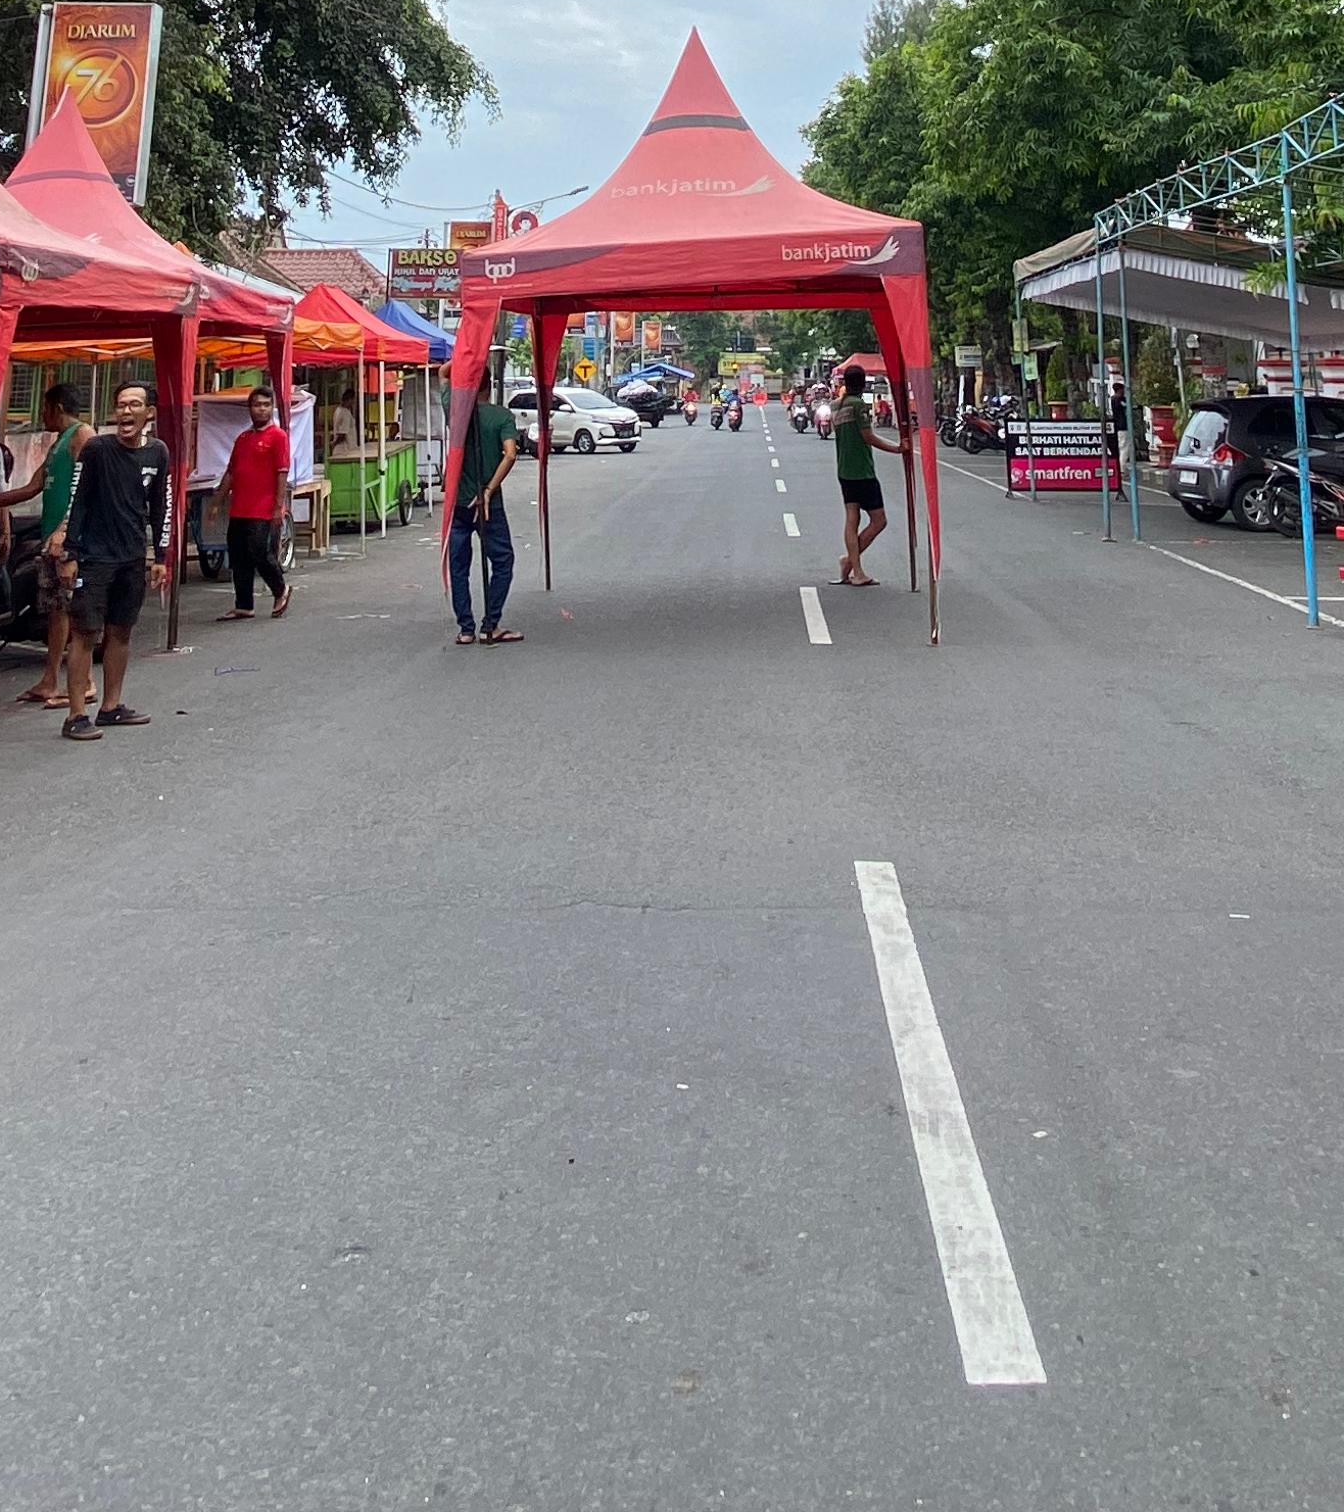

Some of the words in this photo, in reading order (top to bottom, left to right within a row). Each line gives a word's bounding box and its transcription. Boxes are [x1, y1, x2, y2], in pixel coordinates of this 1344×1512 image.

[67, 23, 136, 39] DJARUM
[75, 54, 123, 105] 76
[610, 177, 736, 199] bankjatim
[398, 250, 457, 266] BAKSO
[781, 242, 872, 263] bankjatim
[1019, 436, 1062, 445] BRHATI
[1025, 466, 1092, 480] smartfren
